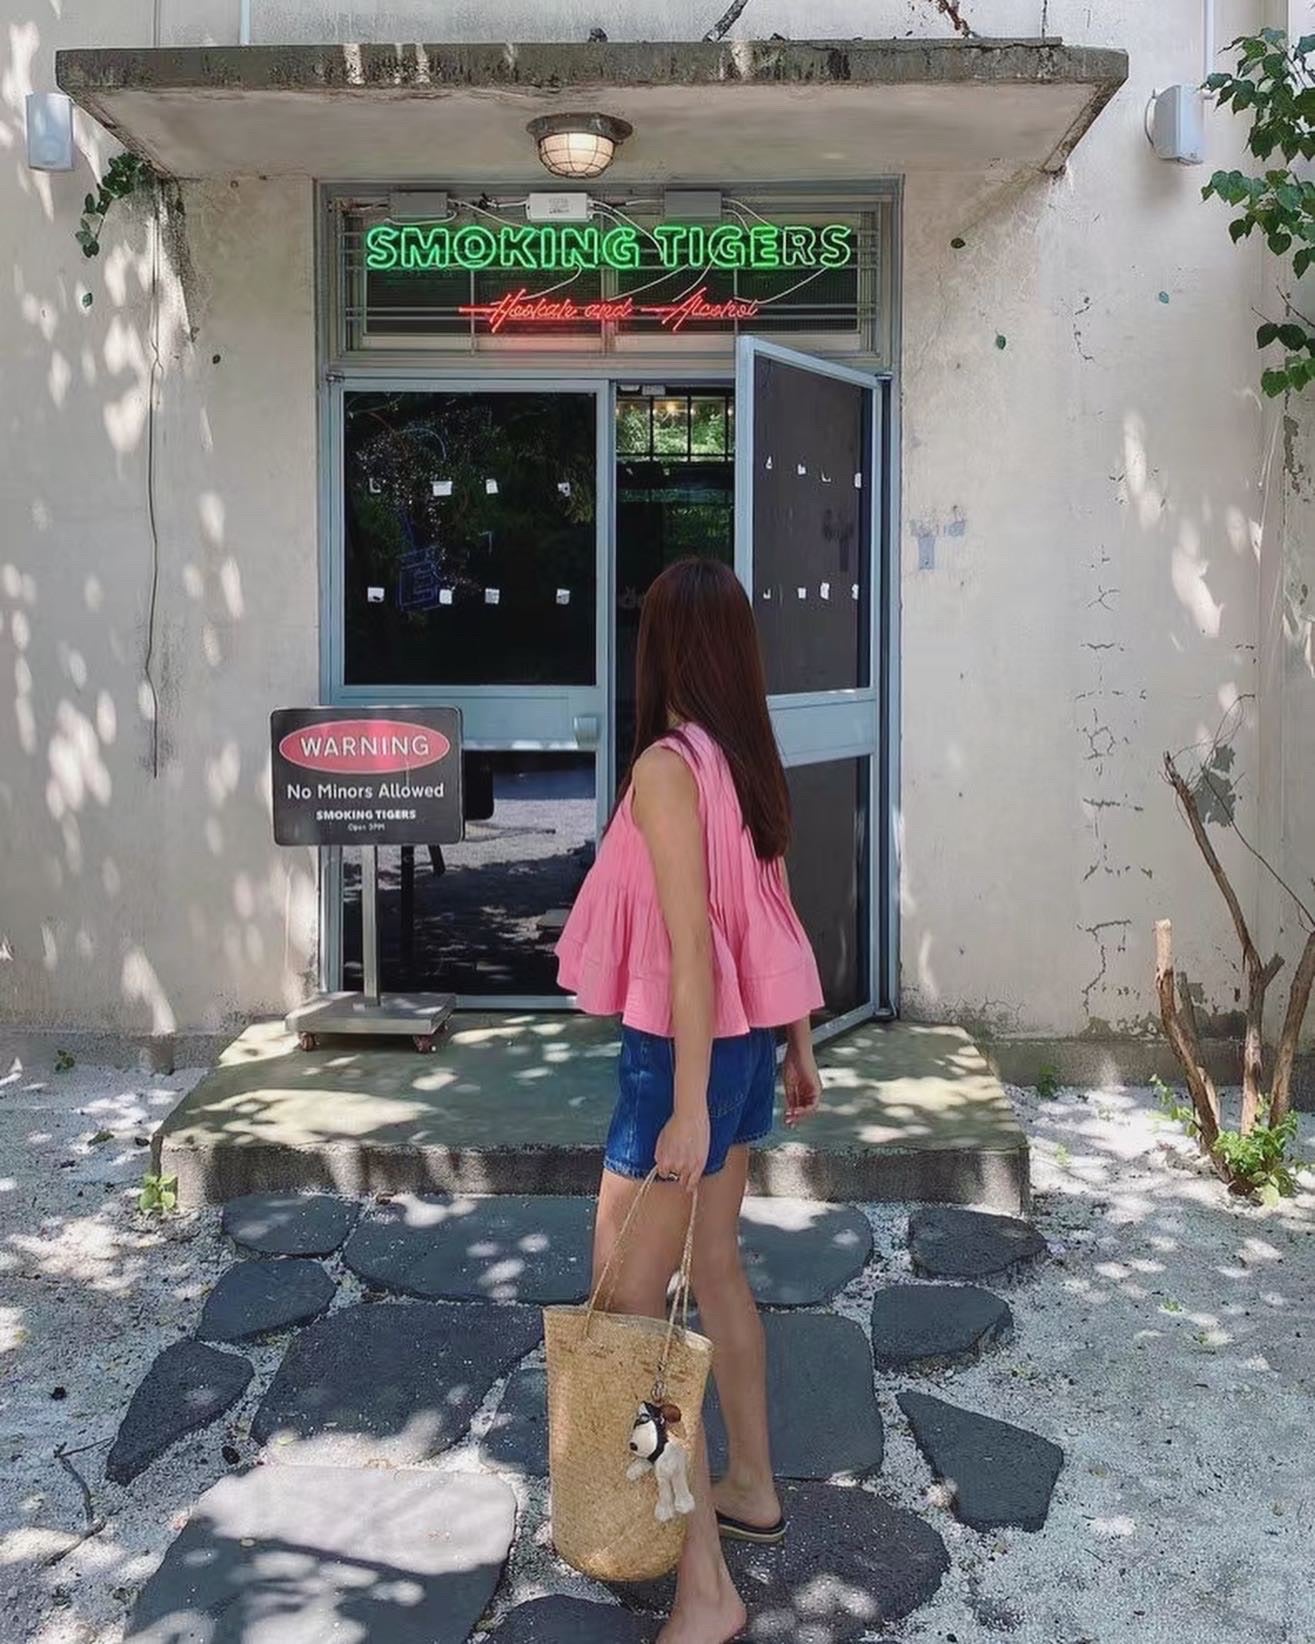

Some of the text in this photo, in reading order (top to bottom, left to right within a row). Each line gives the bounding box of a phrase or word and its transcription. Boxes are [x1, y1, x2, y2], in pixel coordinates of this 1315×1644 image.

[366, 224, 852, 269] SMOKING TIGERS
[459, 286, 758, 333] Hookah and Alcohol
[300, 735, 429, 757] WARNING
[287, 782, 445, 799] No Minors Allowed
[316, 809, 416, 820] SMOKING TIGERS
